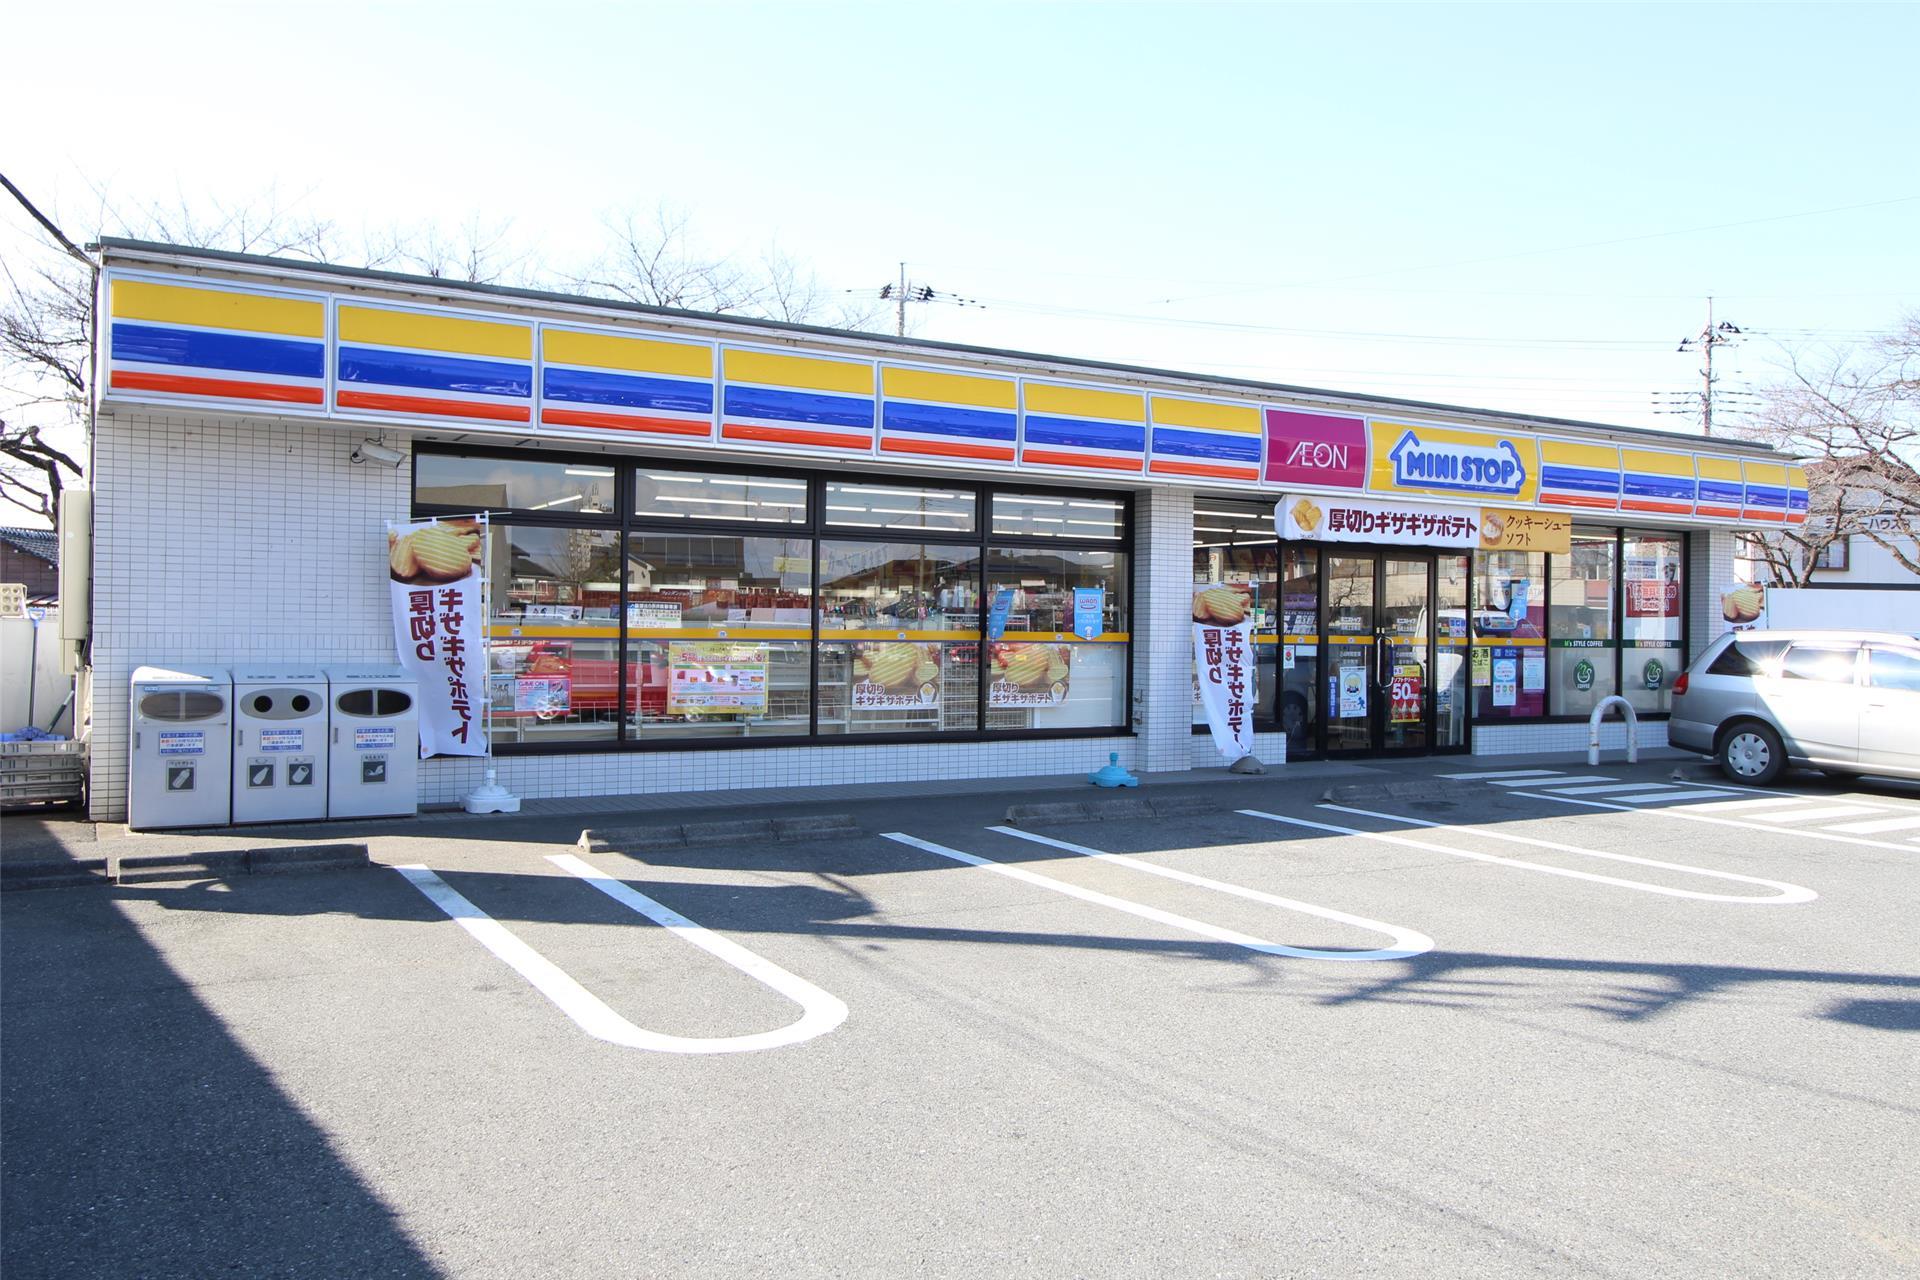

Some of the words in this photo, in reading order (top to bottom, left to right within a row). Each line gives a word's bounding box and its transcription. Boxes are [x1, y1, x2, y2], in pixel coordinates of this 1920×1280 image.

[1406, 451, 1458, 480] MINI
[1460, 456, 1514, 485] STOP
[1328, 508, 1478, 539] 厚切りギザギザポテト
[1506, 514, 1572, 531] クッキーシュー
[1506, 532, 1531, 545] ソフト
